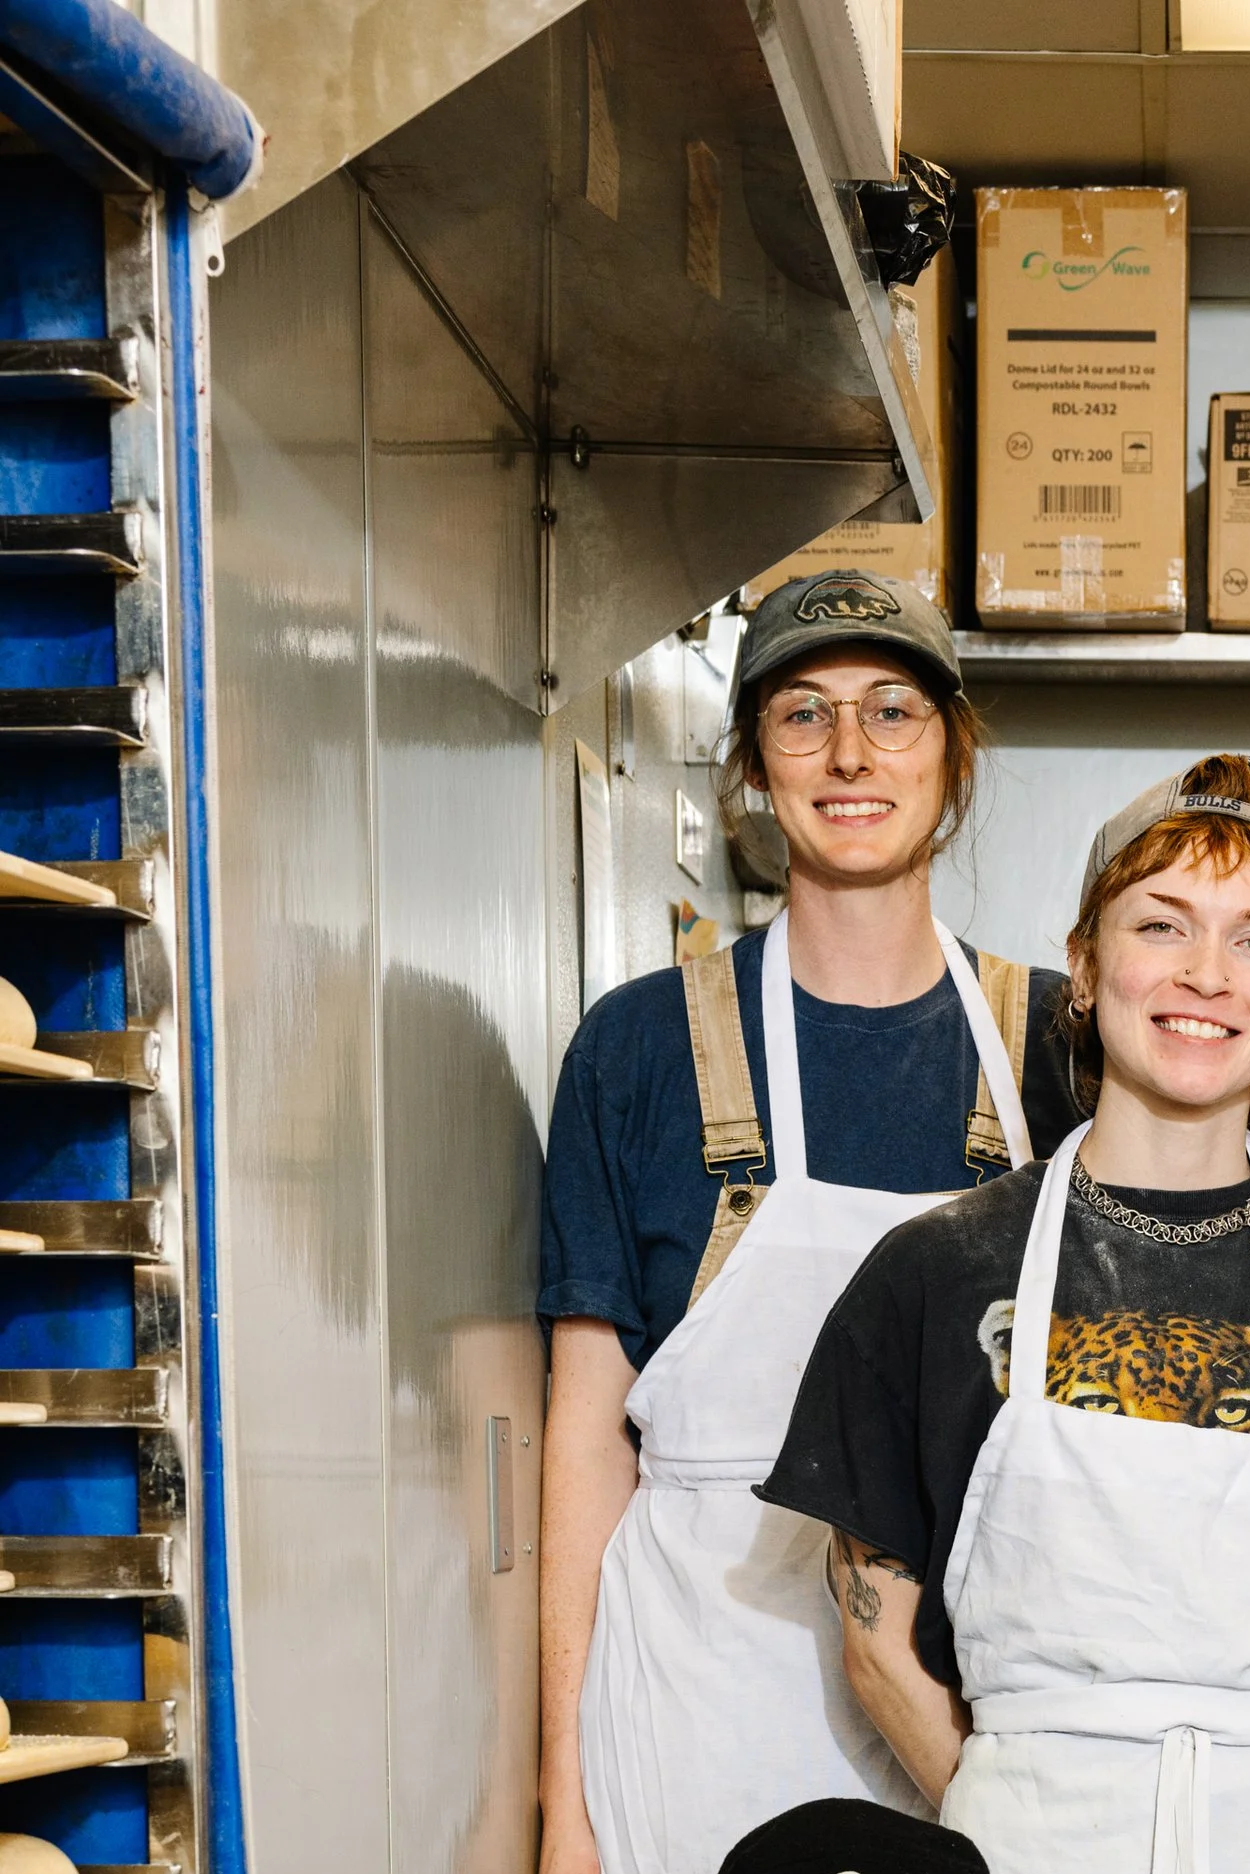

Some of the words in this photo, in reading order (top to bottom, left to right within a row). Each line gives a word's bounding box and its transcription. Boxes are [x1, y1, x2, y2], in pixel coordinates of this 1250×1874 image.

[1052, 261, 1096, 275] Green
[1112, 262, 1151, 275] Wave
[1007, 364, 1038, 375] Dome
[1040, 364, 1057, 375] Lid
[1058, 364, 1074, 375] for
[1076, 364, 1089, 375] 24
[1091, 366, 1103, 375] oz
[1106, 364, 1126, 375] and
[1128, 365, 1141, 375] 32
[1143, 366, 1156, 376] oz
[1012, 380, 1081, 392] Compostable
[1083, 380, 1117, 391] Round
[1119, 381, 1151, 391] Bowls
[1051, 402, 1118, 416] RDL-2432
[1010, 440, 1029, 451] 24
[1051, 449, 1084, 463] QTY:
[1087, 449, 1113, 462] 200
[1184, 795, 1242, 812] BULLS
